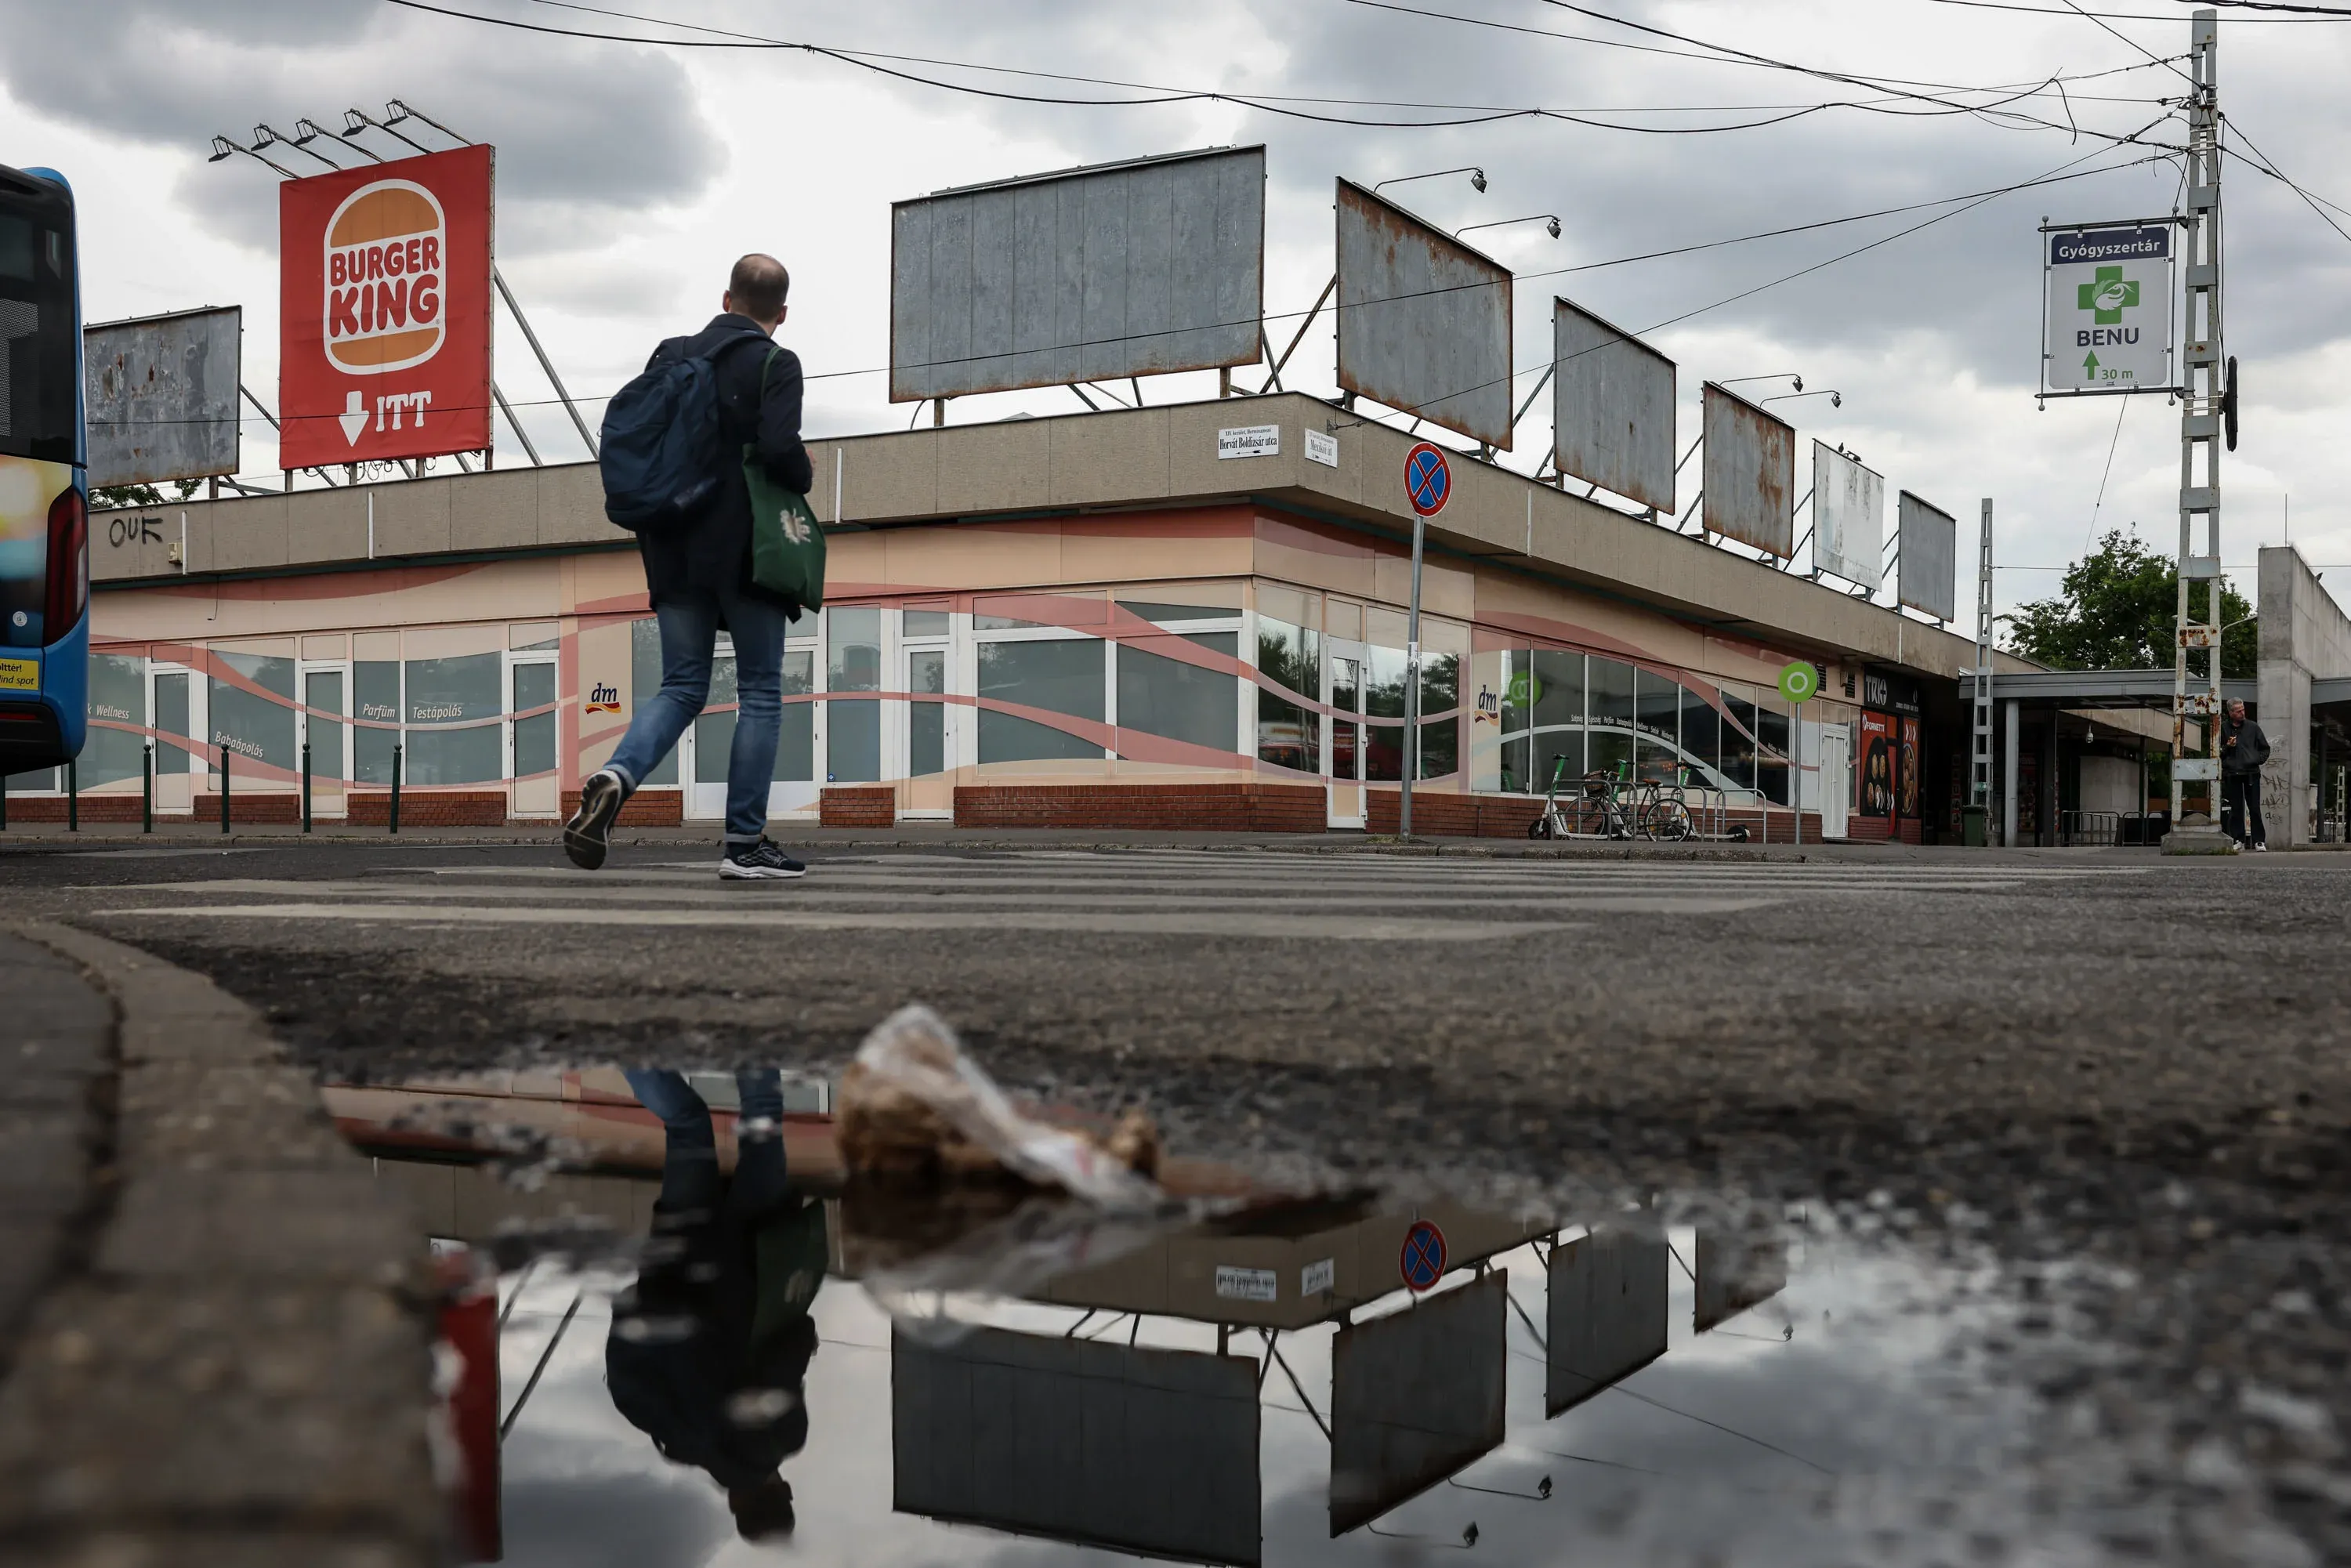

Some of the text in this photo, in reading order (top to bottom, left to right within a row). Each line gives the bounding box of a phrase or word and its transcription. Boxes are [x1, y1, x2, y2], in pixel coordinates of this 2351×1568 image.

[2059, 239, 2161, 259] Gyógyszertár
[330, 236, 440, 287] BURGER
[329, 273, 440, 338] KING
[2077, 328, 2139, 347] BENU
[2101, 369, 2133, 380] 30 m
[375, 390, 432, 432] ITT
[1219, 435, 1278, 450] Horvát Boldizsár utca
[16, 678, 34, 686] spot
[1865, 675, 1887, 705] TRIO
[591, 683, 618, 702] dm
[1478, 684, 1497, 712] dm
[96, 704, 129, 720] Wellness
[363, 704, 462, 721] Parfüm Testápolás
[1867, 721, 1885, 733] FORNETTI
[215, 730, 263, 758] Babaápolás
